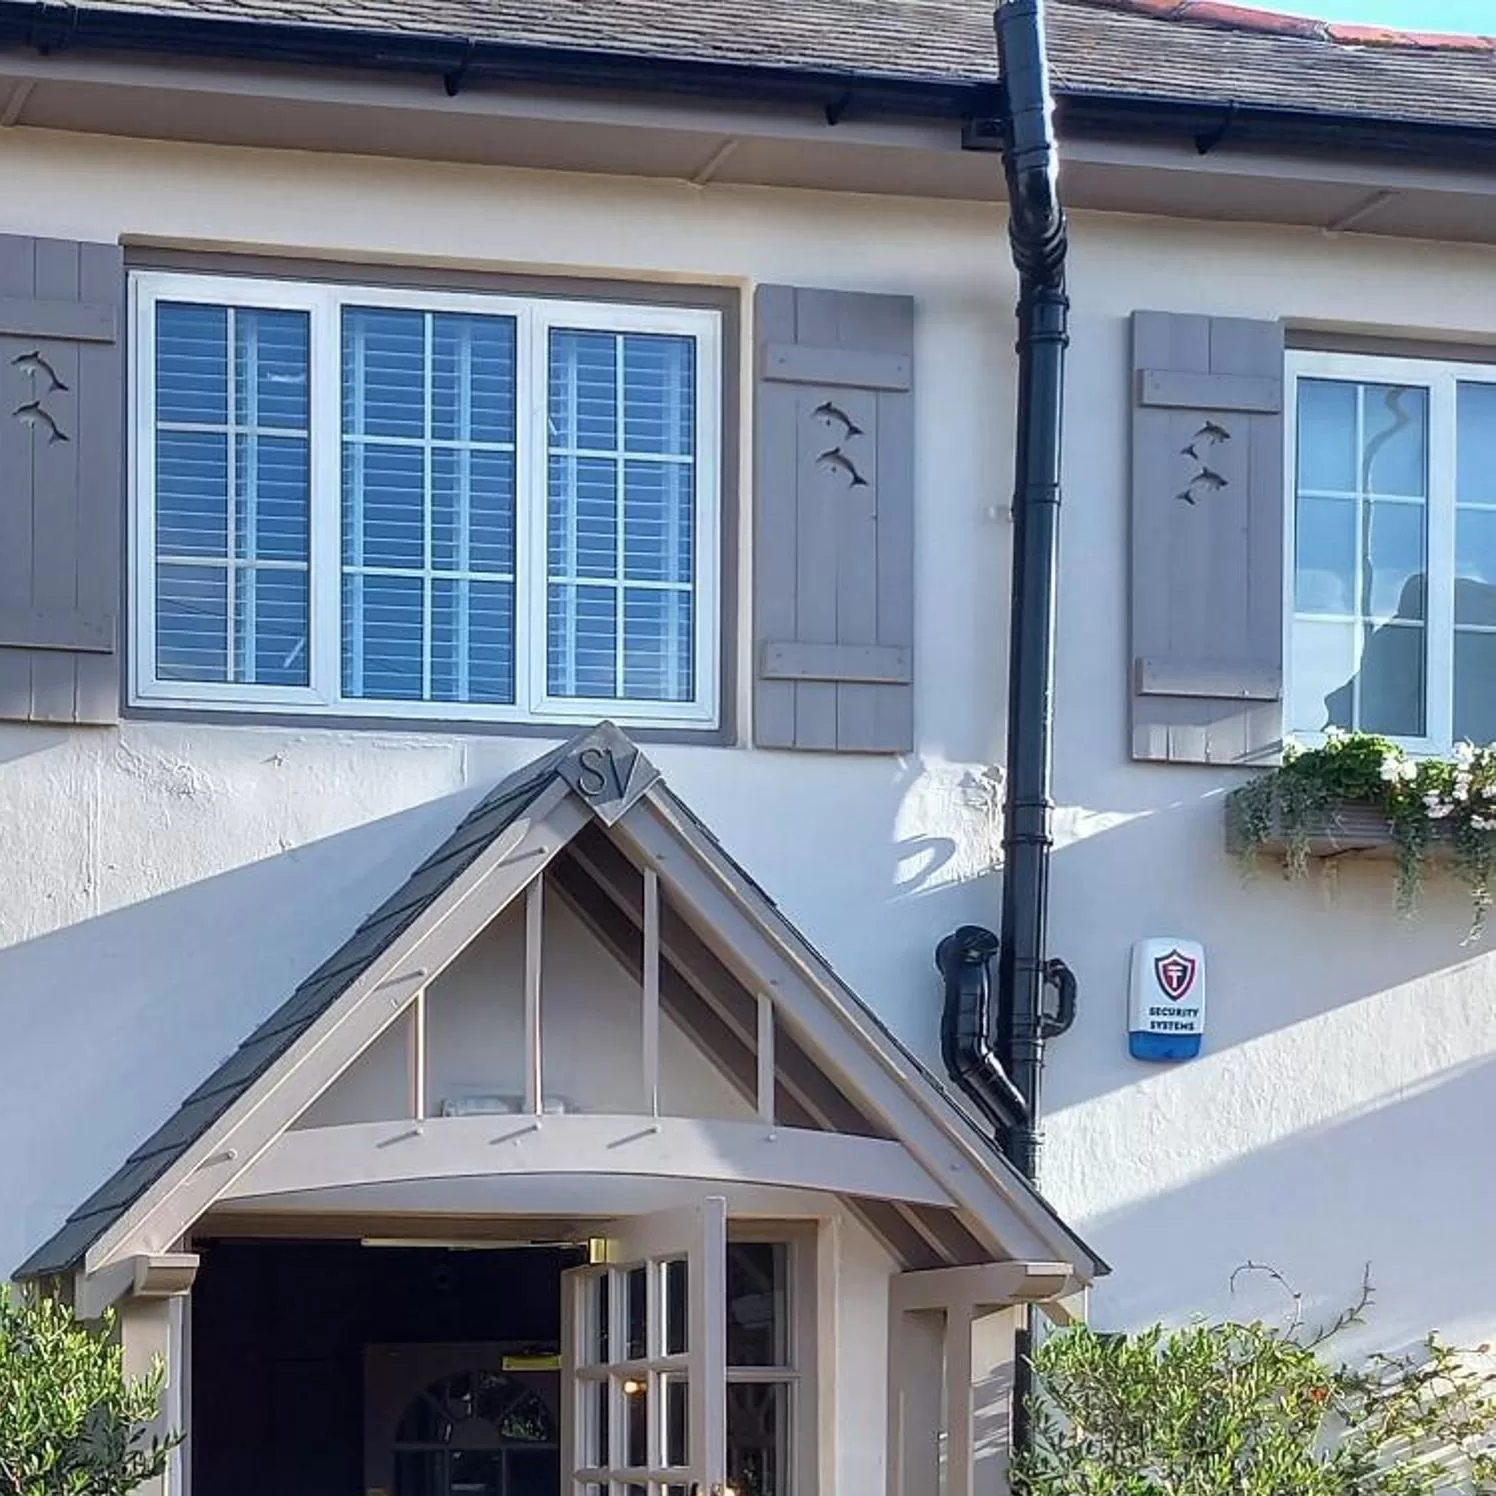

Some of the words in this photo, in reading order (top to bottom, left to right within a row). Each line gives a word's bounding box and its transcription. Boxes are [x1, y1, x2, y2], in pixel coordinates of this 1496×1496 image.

[578, 747, 639, 801] SV
[1149, 1006, 1199, 1018] SECURITY
[1150, 1020, 1195, 1031] SYSTEMS
